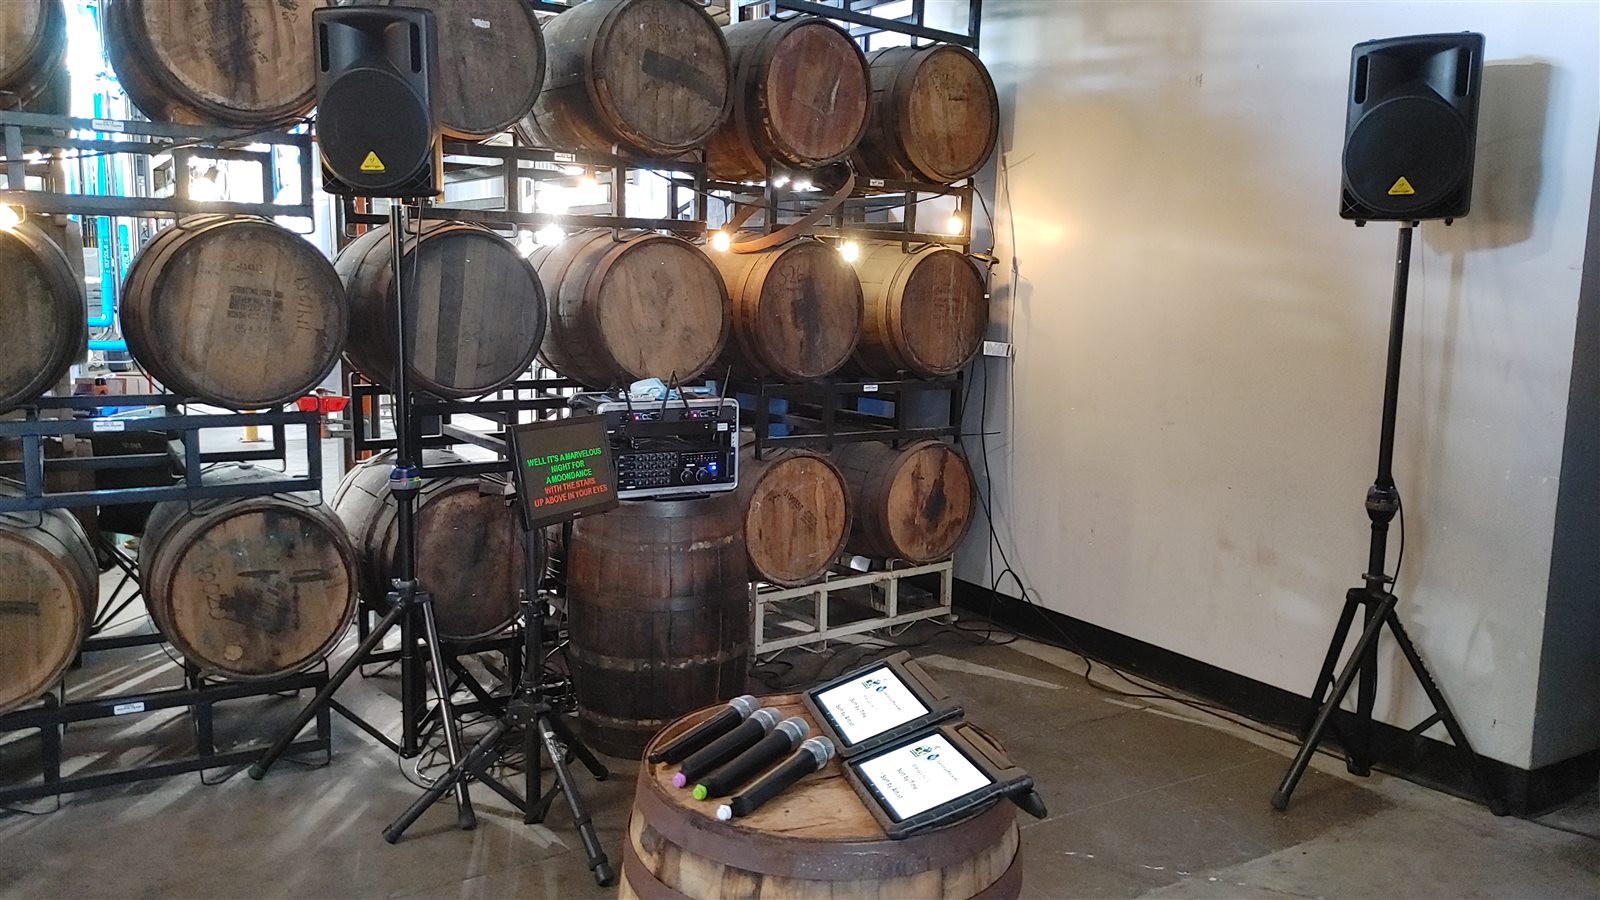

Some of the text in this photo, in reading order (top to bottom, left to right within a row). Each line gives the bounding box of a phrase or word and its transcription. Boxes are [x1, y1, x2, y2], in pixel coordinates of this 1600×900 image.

[526, 458, 547, 467] WELL
[547, 455, 559, 464] IT'S
[566, 448, 602, 460] MARVELOUS
[551, 460, 585, 473] NIGHT FOR
[546, 468, 593, 484] A MOONDANCE
[544, 477, 596, 494] WITH THE STARS
[534, 484, 608, 508] UP ABOVE IN YOUR EYES
